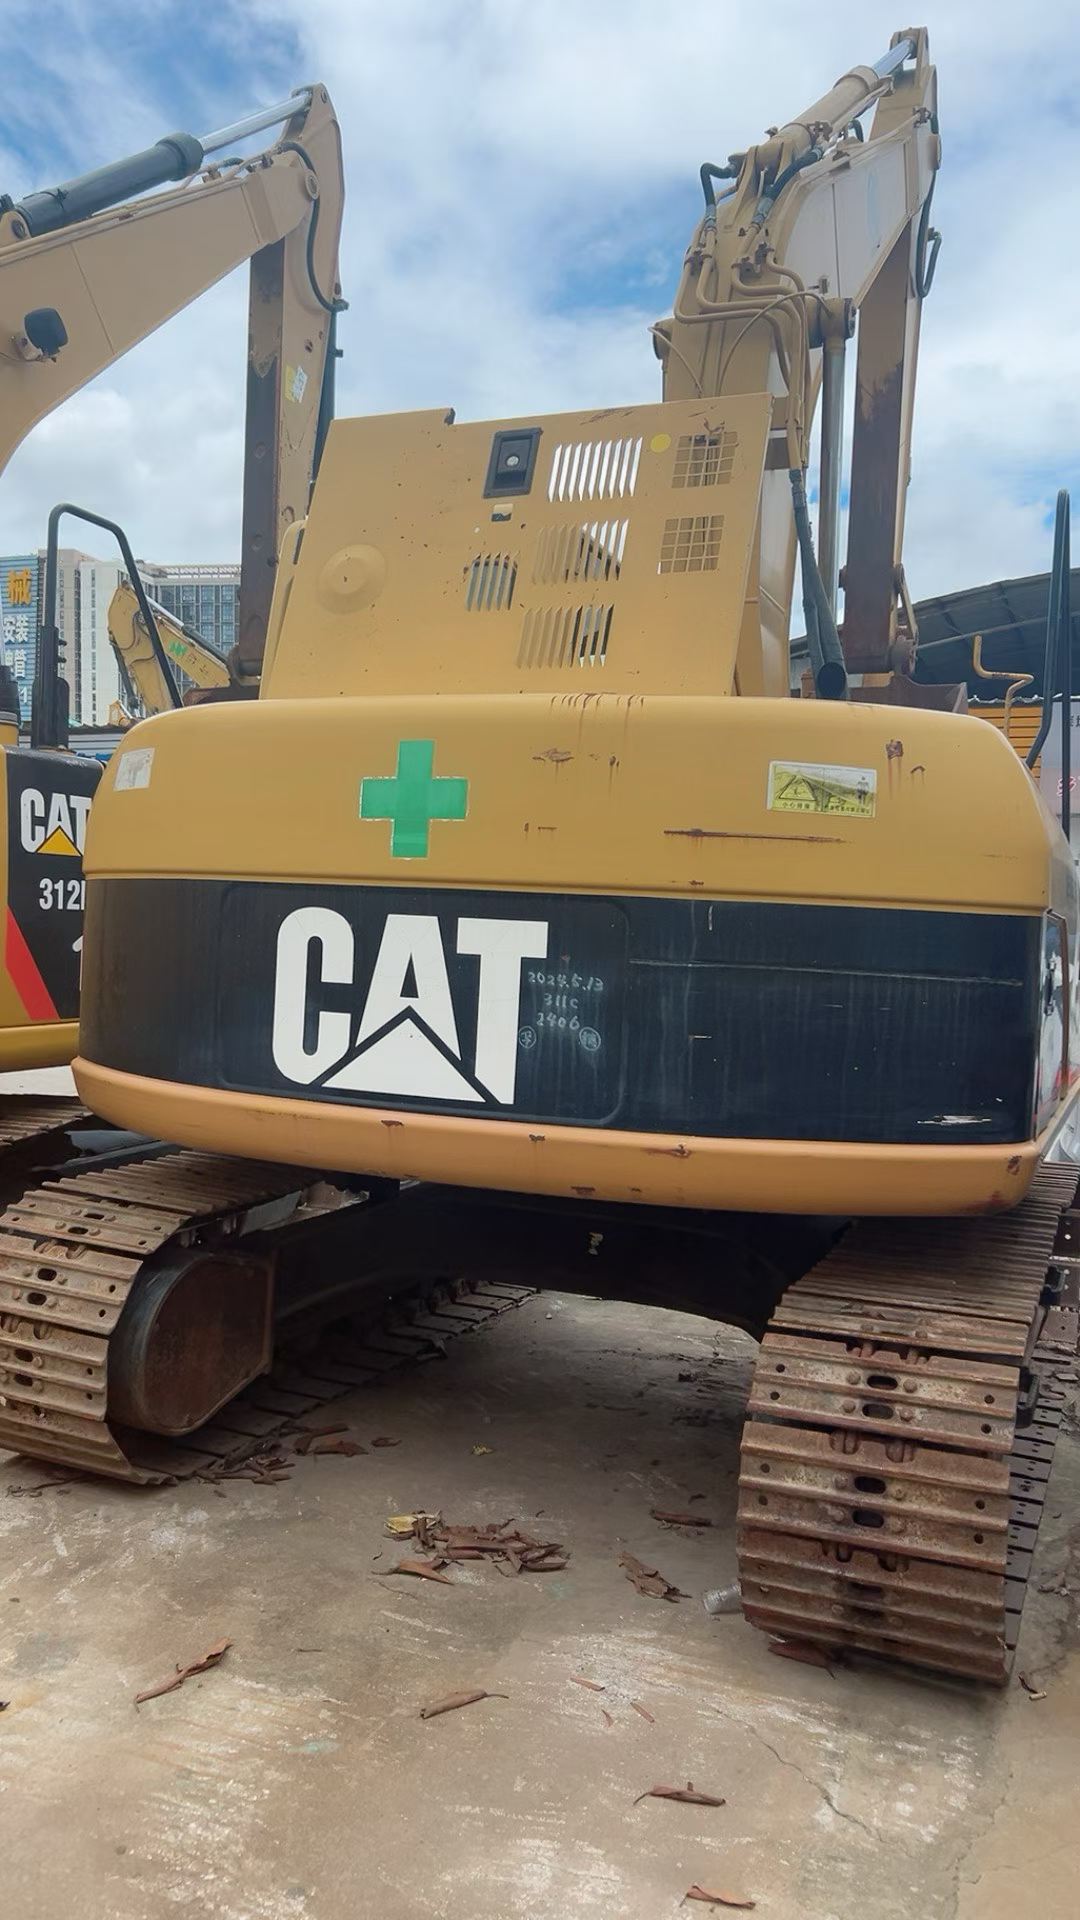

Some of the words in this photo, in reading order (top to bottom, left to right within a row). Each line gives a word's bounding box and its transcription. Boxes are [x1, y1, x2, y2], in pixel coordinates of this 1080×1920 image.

[20, 787, 92, 857] CAT
[527, 968, 604, 992] 2024.5.13
[271, 906, 548, 1105] CAT
[536, 1012, 580, 1030] 2406
